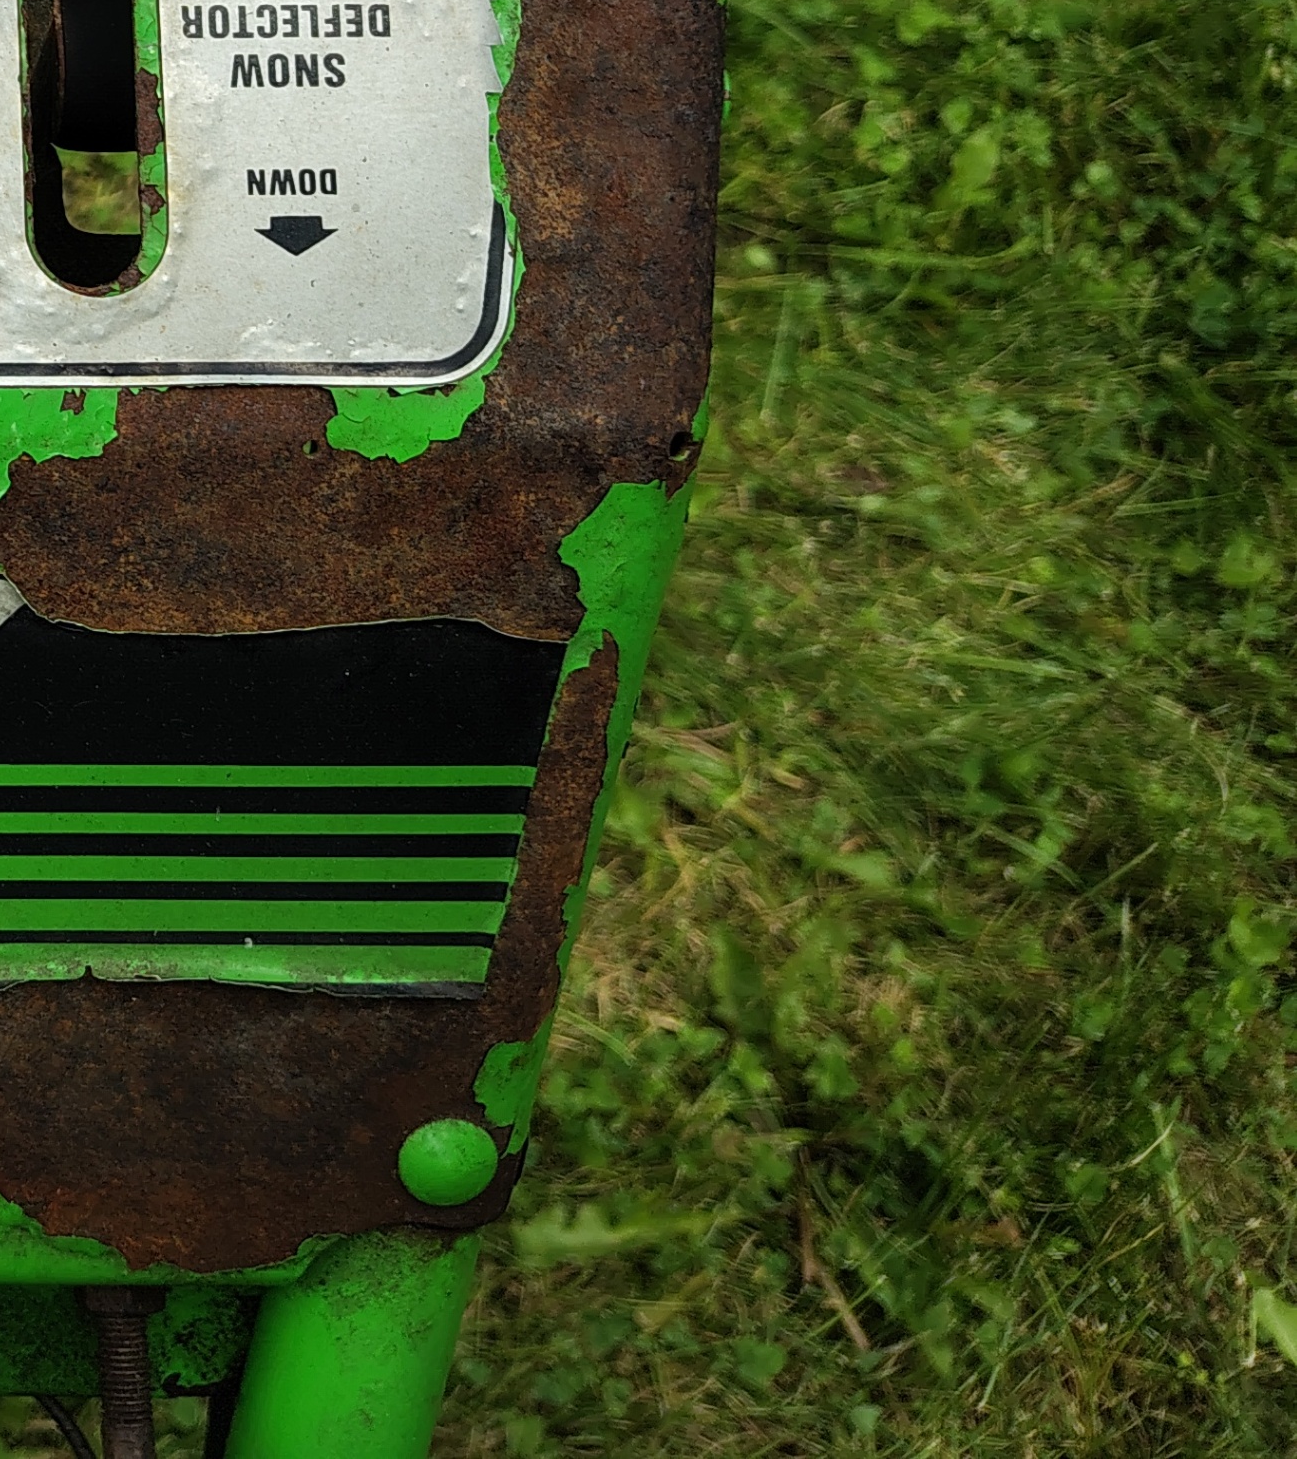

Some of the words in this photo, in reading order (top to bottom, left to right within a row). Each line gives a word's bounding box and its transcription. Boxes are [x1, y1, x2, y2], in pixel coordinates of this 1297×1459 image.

[181, 3, 391, 39] DEFLECTOR
[230, 53, 346, 88] SNOW
[246, 168, 338, 196] DOWN
